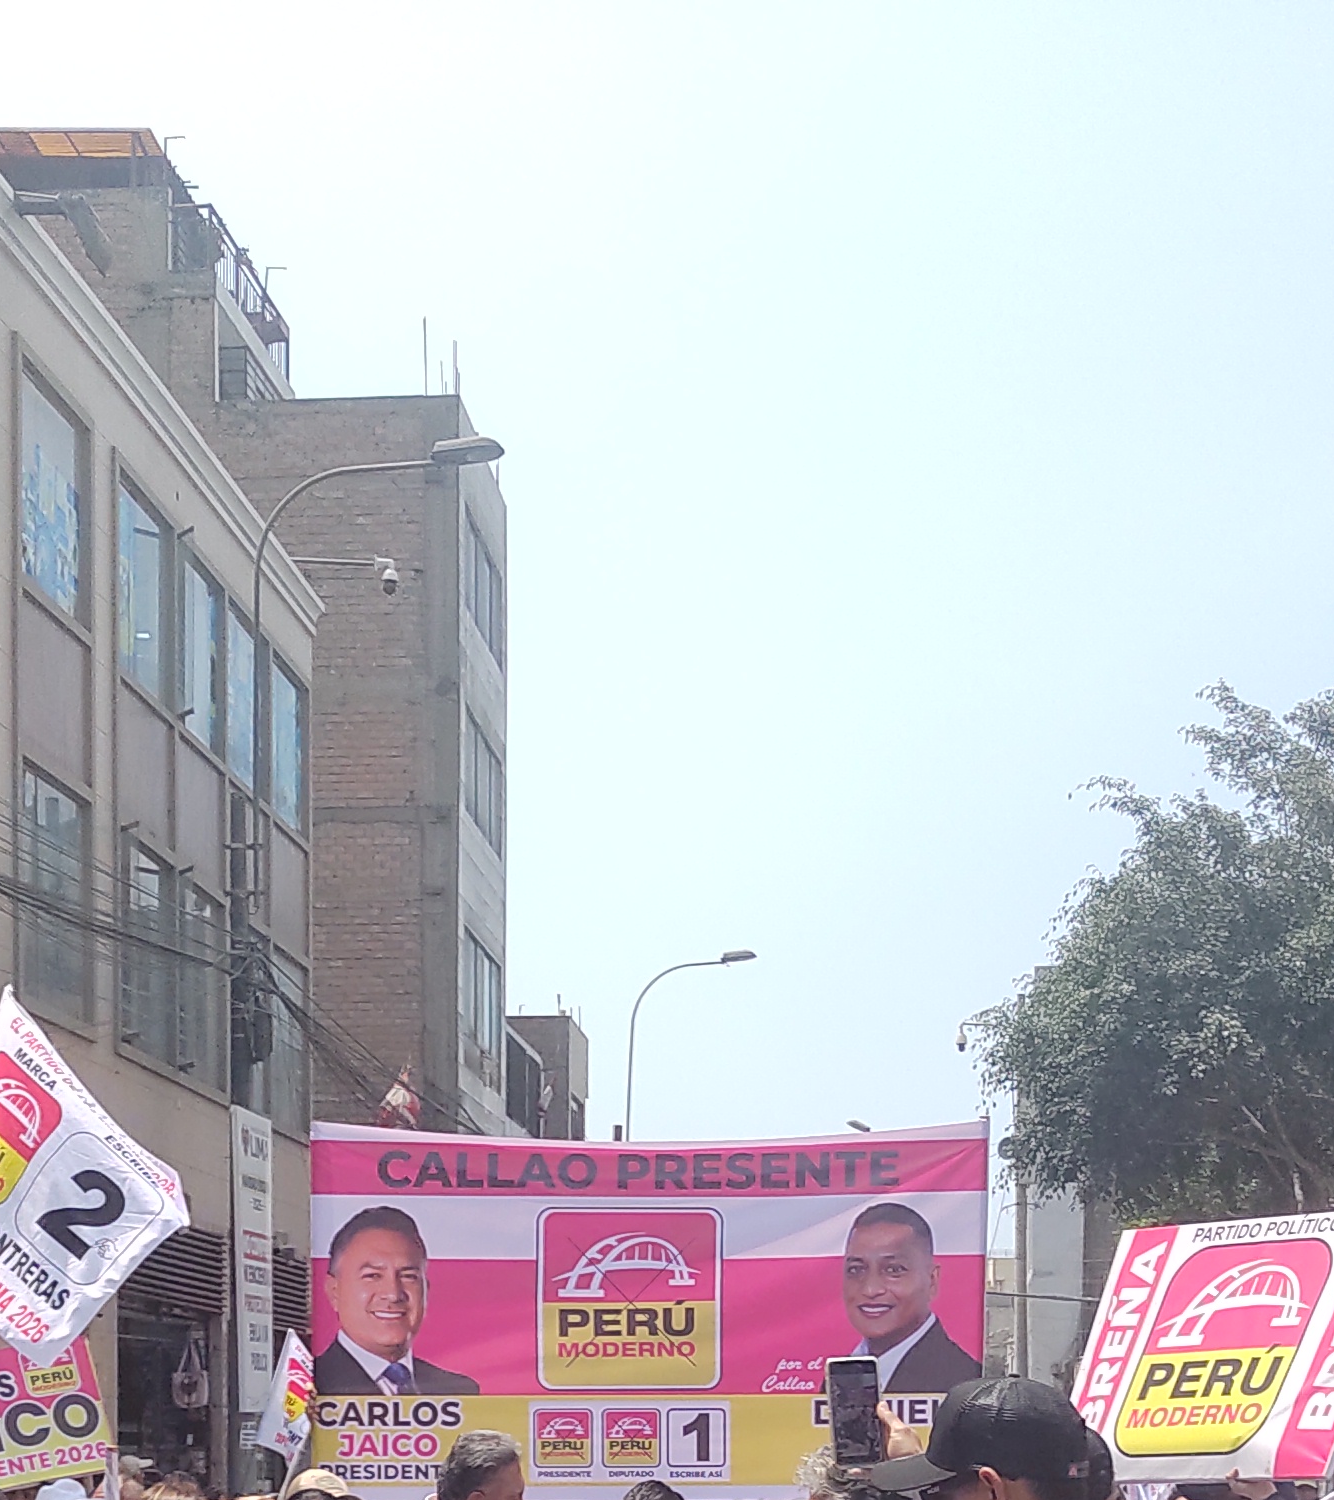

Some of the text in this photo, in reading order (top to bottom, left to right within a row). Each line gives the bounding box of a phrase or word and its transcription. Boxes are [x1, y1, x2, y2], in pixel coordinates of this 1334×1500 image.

[10, 1016, 21, 1034] EL
[13, 1047, 58, 1092] MARCA
[377, 1149, 900, 1191] CALLAO PRESENTE
[35, 1169, 126, 1262] 2
[1192, 1222, 1262, 1244] PARTIDO
[5, 1304, 51, 1344] 2026
[557, 1299, 697, 1339] PERÚ
[1080, 1240, 1169, 1427] BREÑA
[556, 1341, 697, 1359] MODERNO
[29, 1366, 75, 1387] PERÚ
[775, 1356, 824, 1374] por el
[1136, 1343, 1286, 1402] PERÚ
[761, 1374, 816, 1393] Callao
[317, 1400, 462, 1427] CARLOS
[1124, 1402, 1263, 1430] MODERNO
[338, 1433, 439, 1458] JAICO
[682, 1412, 711, 1462] 1
[53, 1441, 109, 1466] 2026
[319, 1463, 442, 1480] PRESIDENT
[537, 1470, 592, 1479] PRESIDENTE
[608, 1470, 655, 1478] DIPUTADO
[669, 1469, 723, 1479] ESCRIBE ASÍ
